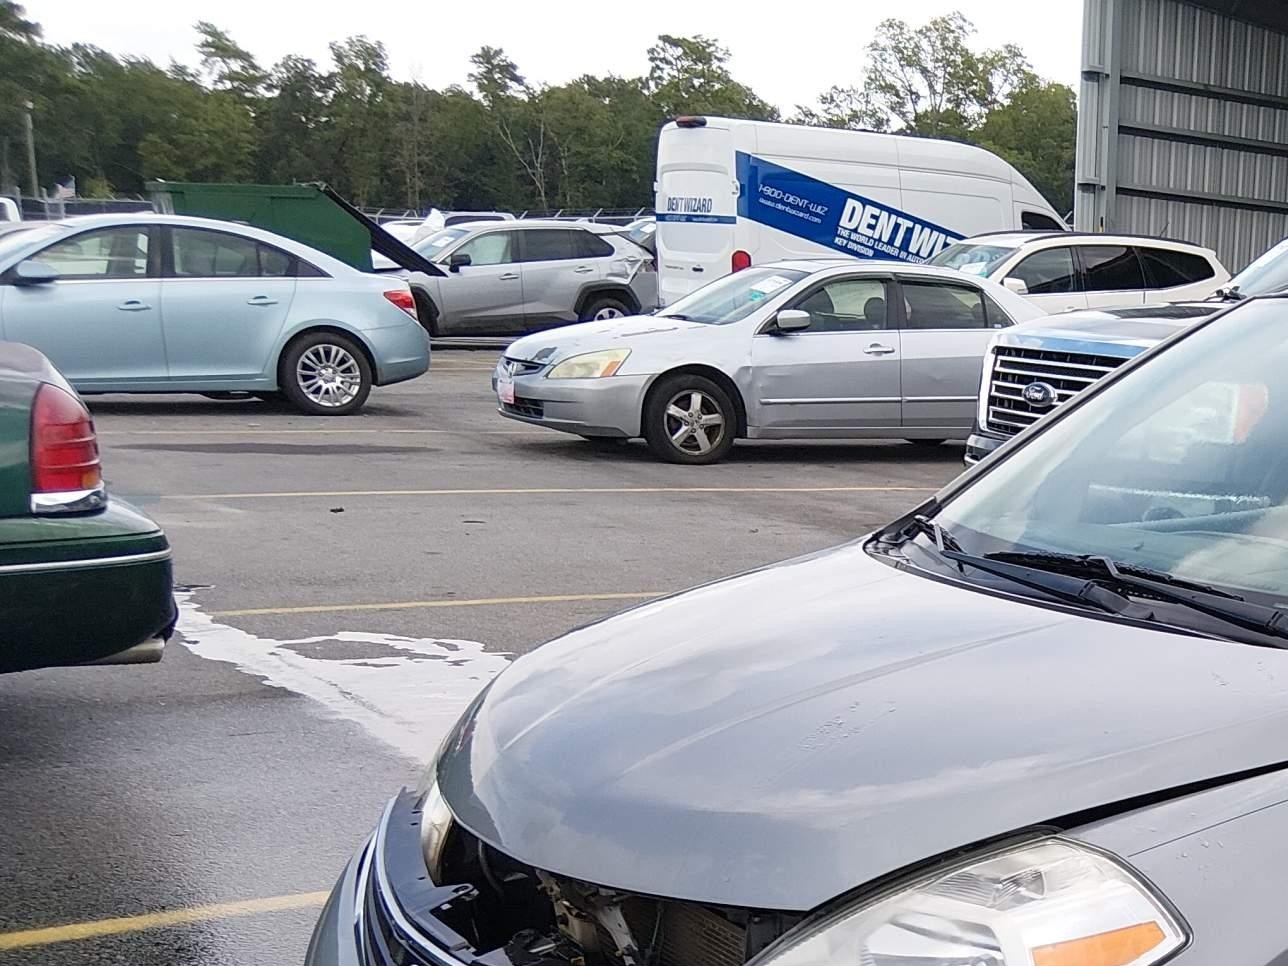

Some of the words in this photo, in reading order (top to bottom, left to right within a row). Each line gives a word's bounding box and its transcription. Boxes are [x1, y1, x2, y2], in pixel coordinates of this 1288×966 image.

[667, 197, 684, 212] DENT
[684, 197, 713, 213] WIZARD
[839, 197, 914, 248] DENT
[834, 236, 847, 247] KEY
[847, 240, 874, 257] DIVISION
[837, 226, 849, 238] THE
[850, 230, 874, 247] WORLD
[874, 239, 900, 257] LEADER
